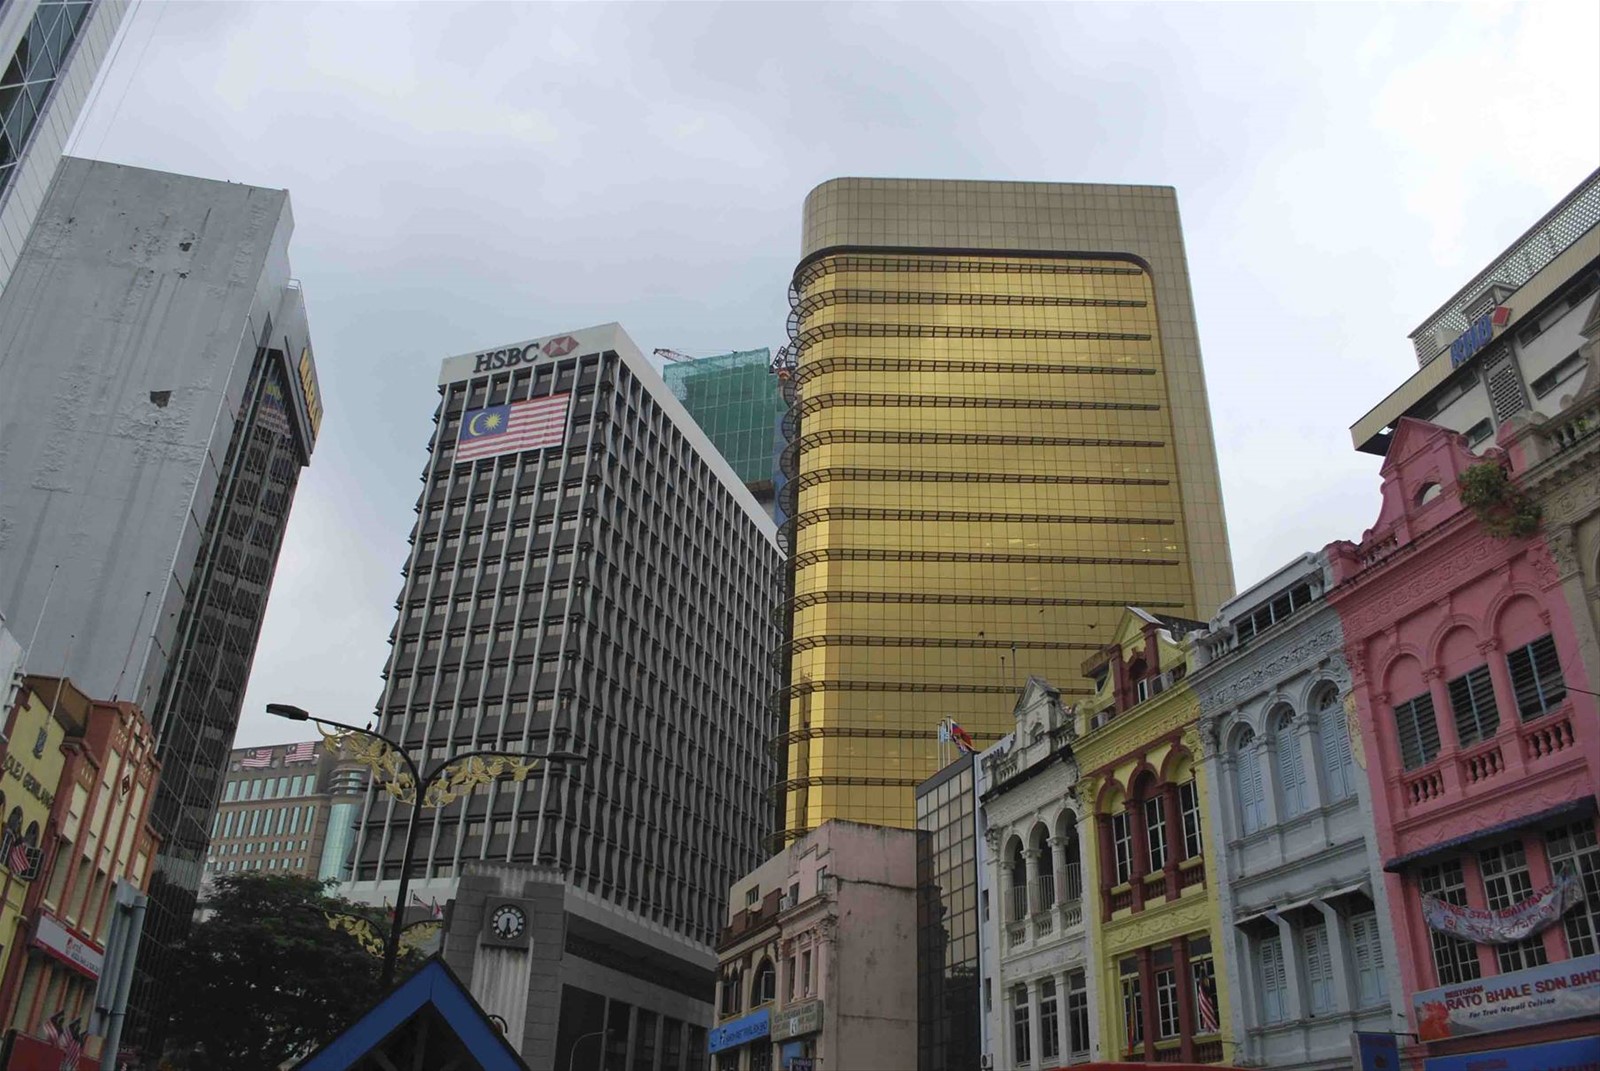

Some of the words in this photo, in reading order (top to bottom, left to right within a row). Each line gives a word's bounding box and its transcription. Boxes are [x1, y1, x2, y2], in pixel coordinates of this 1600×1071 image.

[473, 342, 540, 373] HSBC
[1446, 994, 1483, 1011] RATO
[1486, 983, 1532, 1004] BHALE
[1501, 1003, 1526, 1014] Nepali
